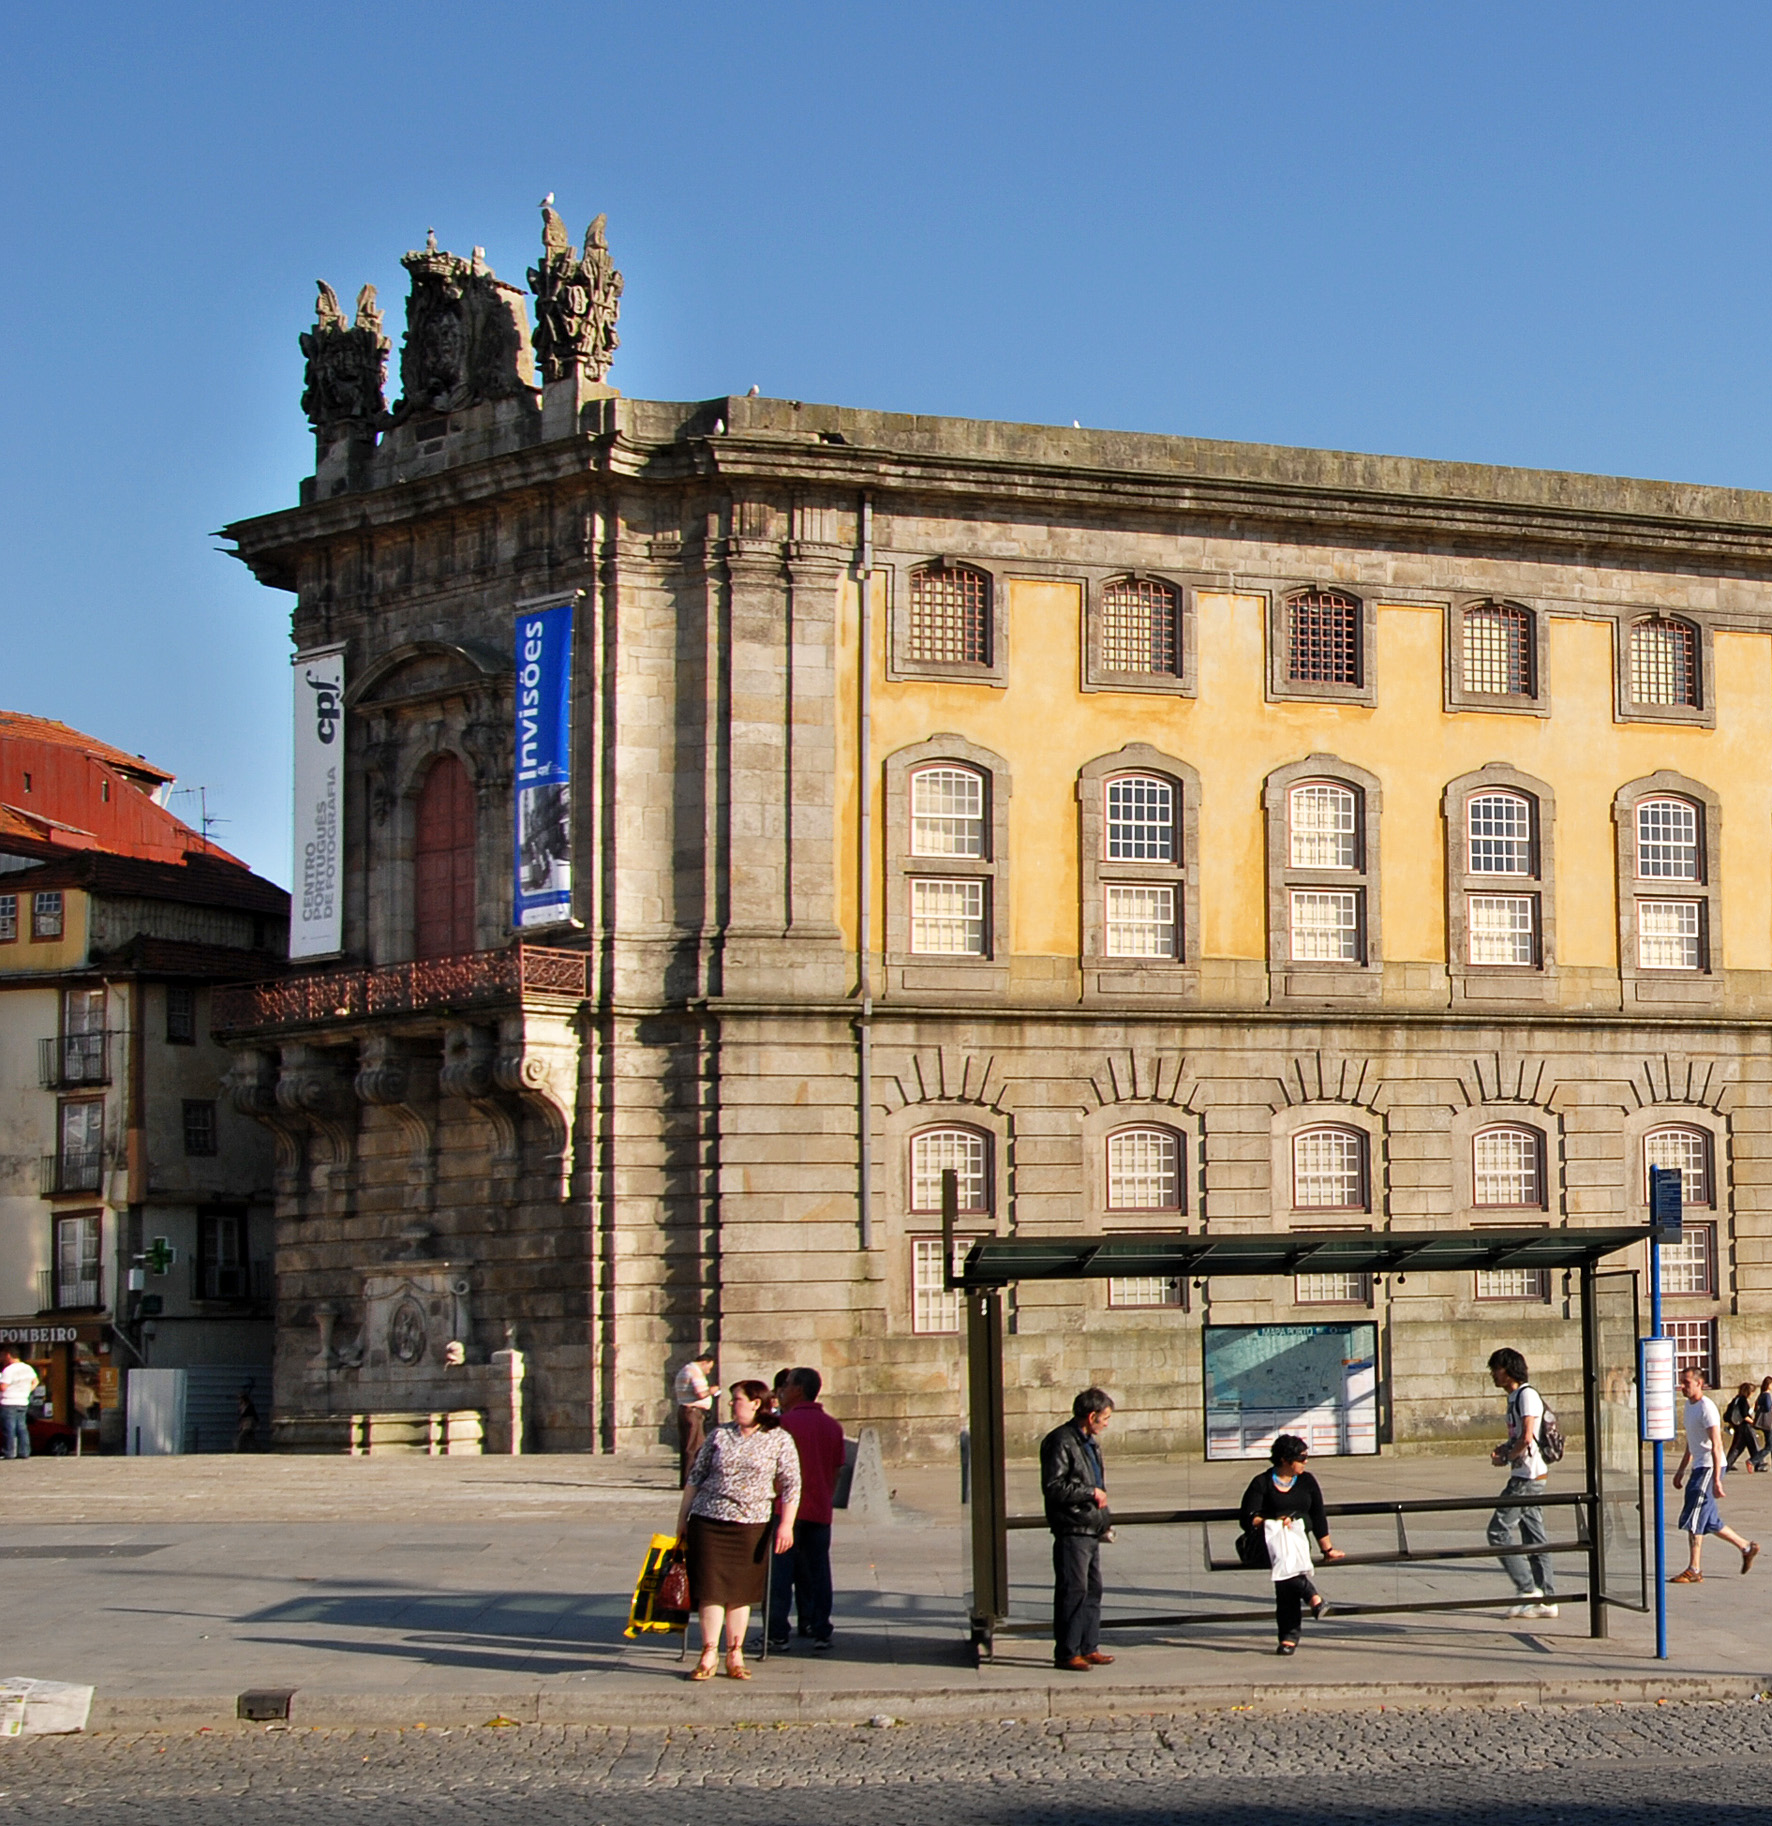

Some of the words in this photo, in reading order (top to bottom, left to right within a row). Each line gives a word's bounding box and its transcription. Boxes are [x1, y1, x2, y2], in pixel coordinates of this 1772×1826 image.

[518, 620, 543, 781] Invisões
[312, 800, 327, 921] PORTUGUÊS
[325, 766, 337, 891] FOTOGRAFIA
[302, 842, 316, 922] CENTRO
[324, 893, 334, 919] DE
[0, 1328, 77, 1342] POMBEIRO
